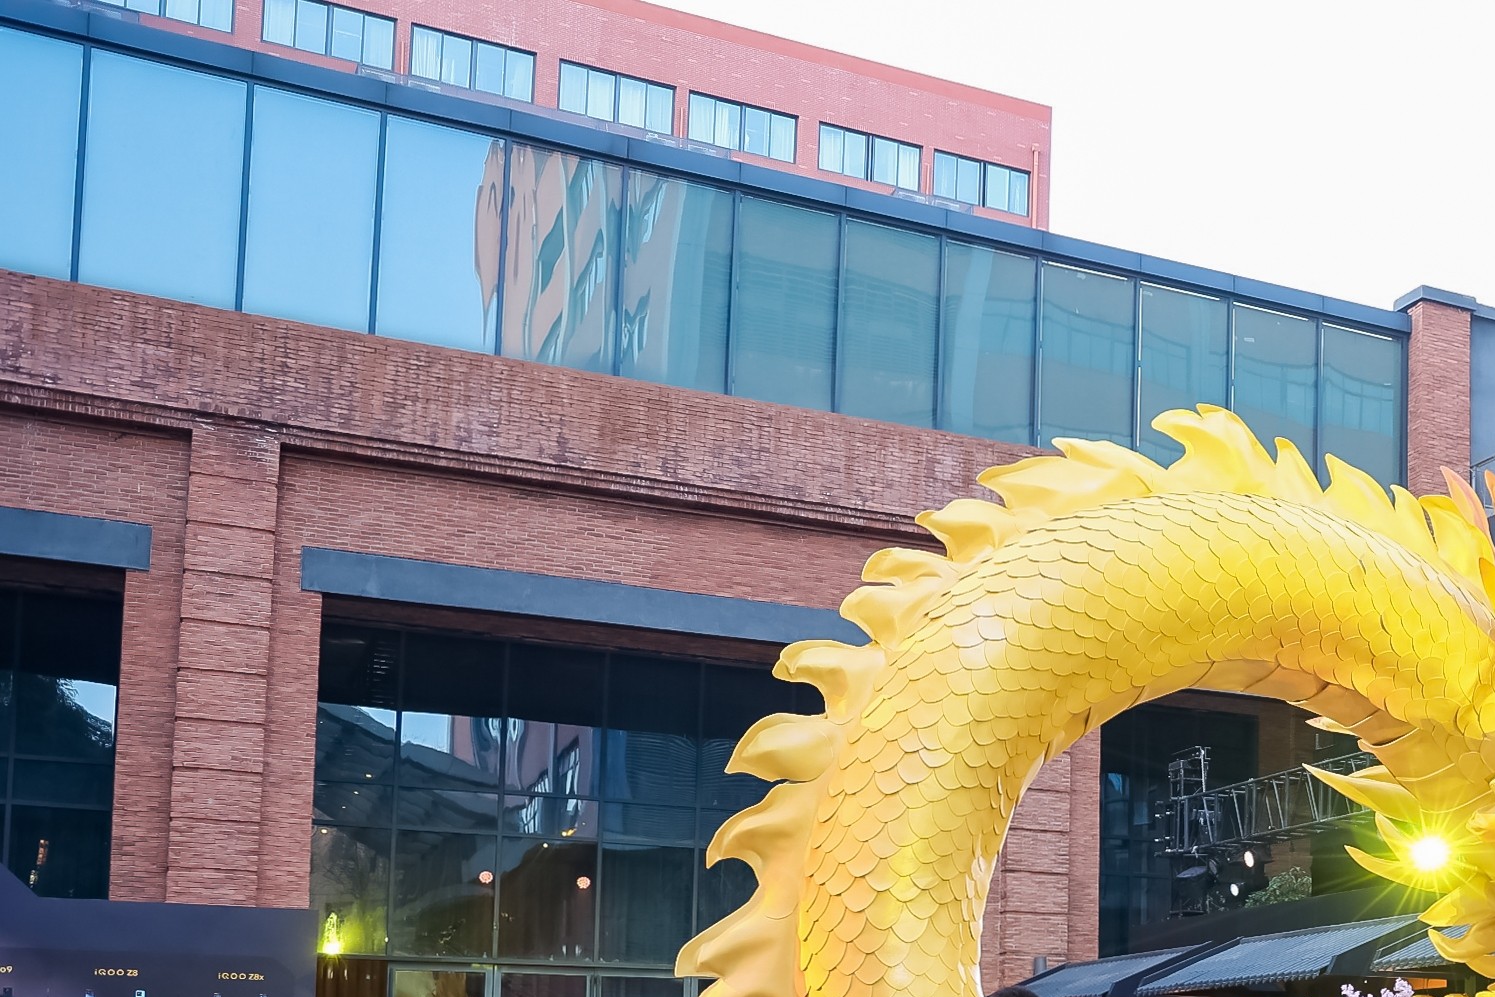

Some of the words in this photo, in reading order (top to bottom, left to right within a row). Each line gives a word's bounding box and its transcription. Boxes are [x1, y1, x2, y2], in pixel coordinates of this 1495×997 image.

[94, 968, 125, 976] iQOO
[126, 969, 139, 977] Z8
[218, 971, 246, 980] iQOO
[248, 973, 265, 981] Z8x
